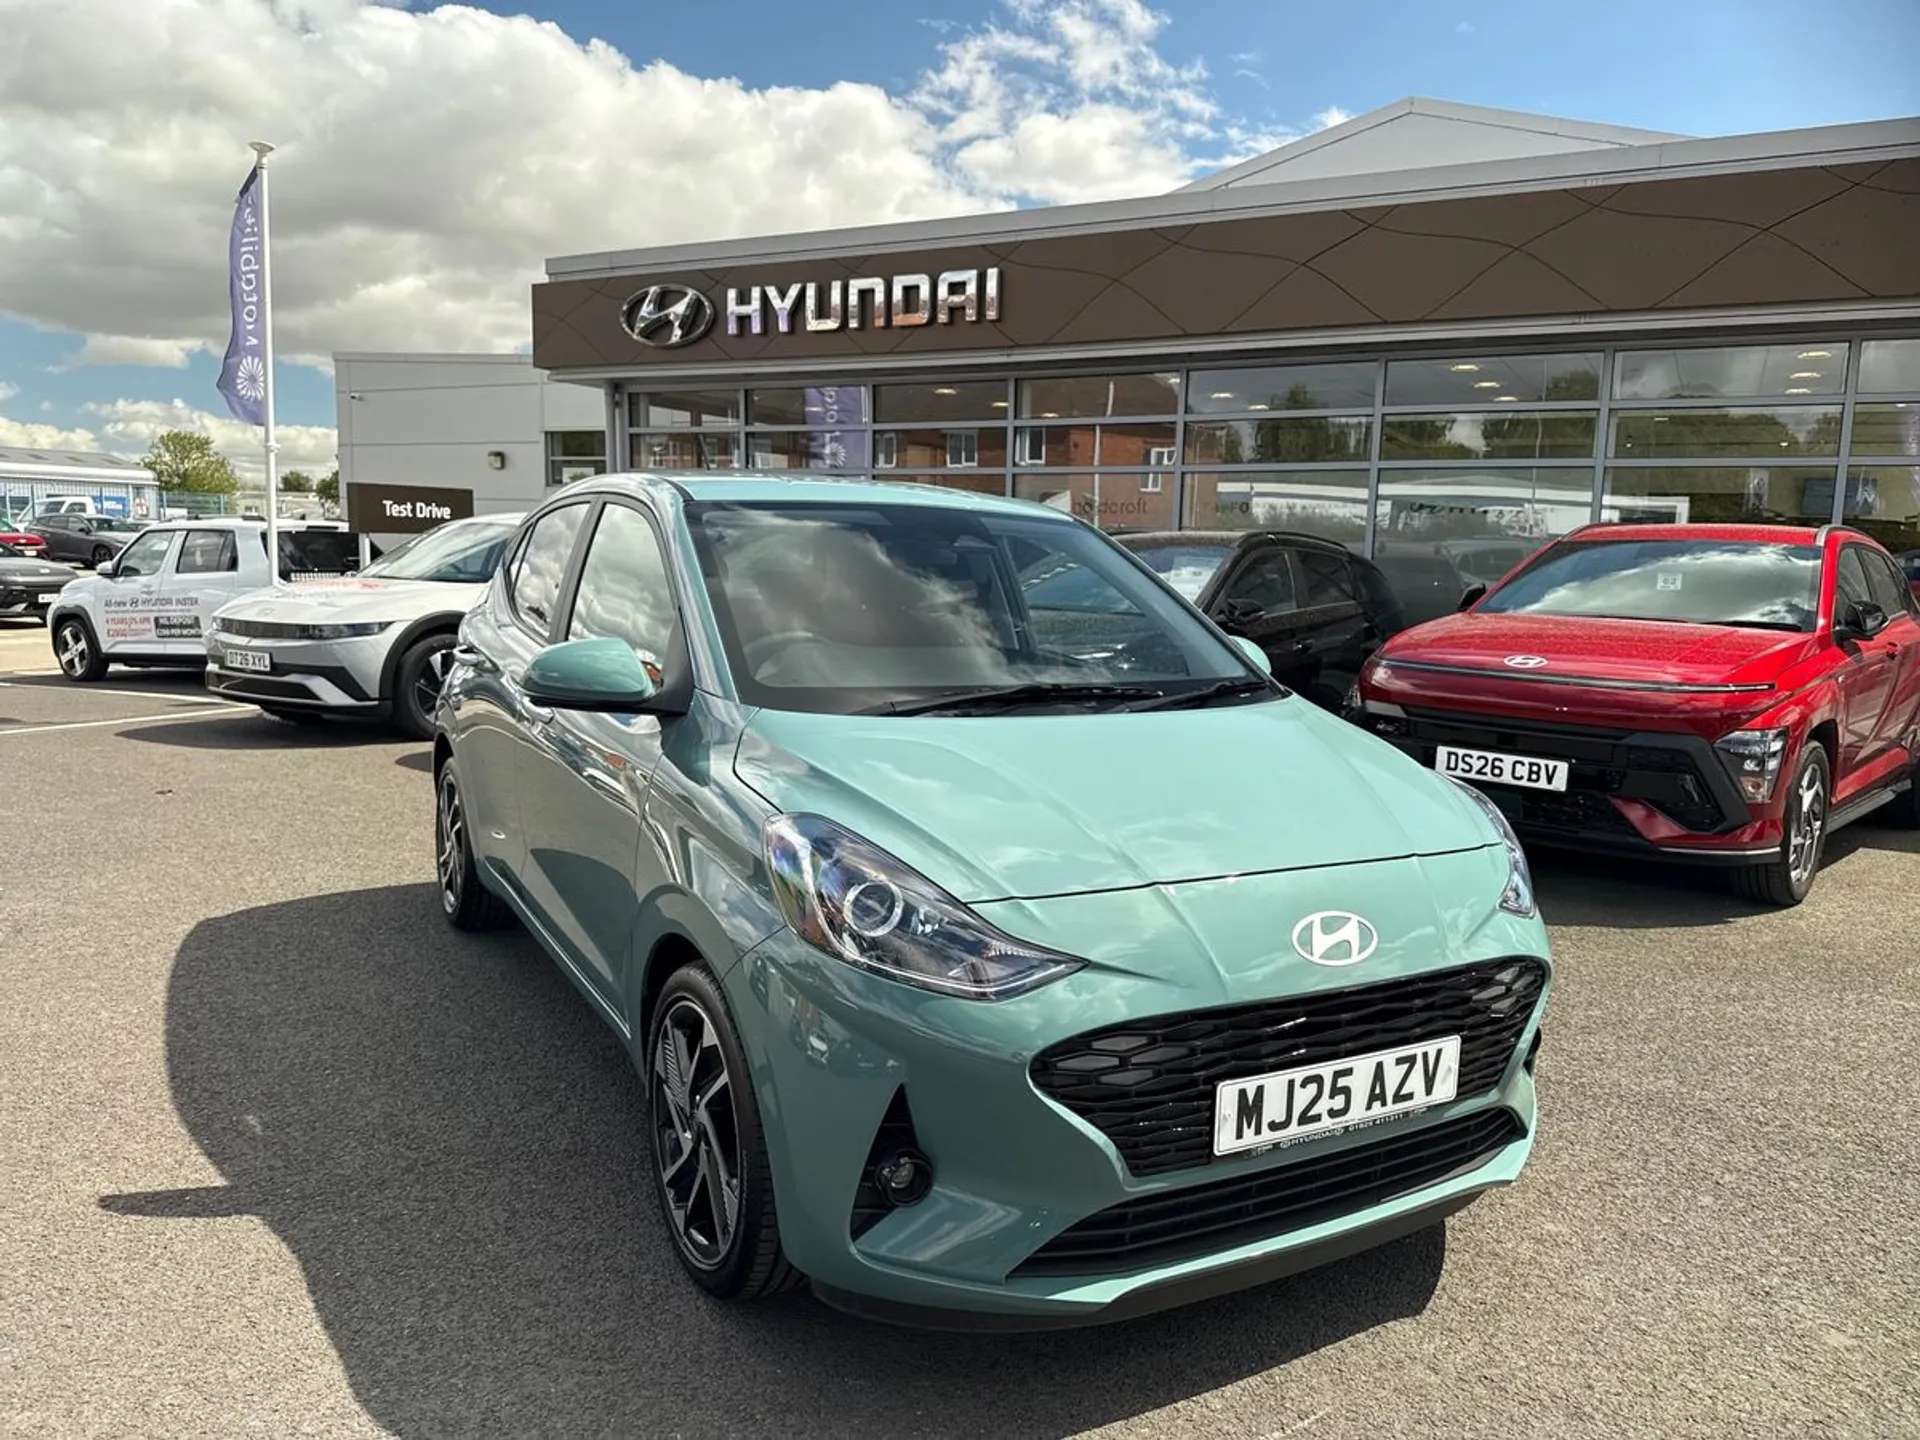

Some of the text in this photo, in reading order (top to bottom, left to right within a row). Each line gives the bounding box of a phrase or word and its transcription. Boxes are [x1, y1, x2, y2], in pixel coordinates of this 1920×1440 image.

[726, 267, 999, 335] HYUNDAI
[382, 500, 451, 519] Test Drive
[1072, 497, 1147, 514] hodcroft
[251, 653, 269, 669] XYL
[1445, 751, 1557, 785] DS26 CBV
[1235, 1048, 1443, 1140] MJ25 AZV
